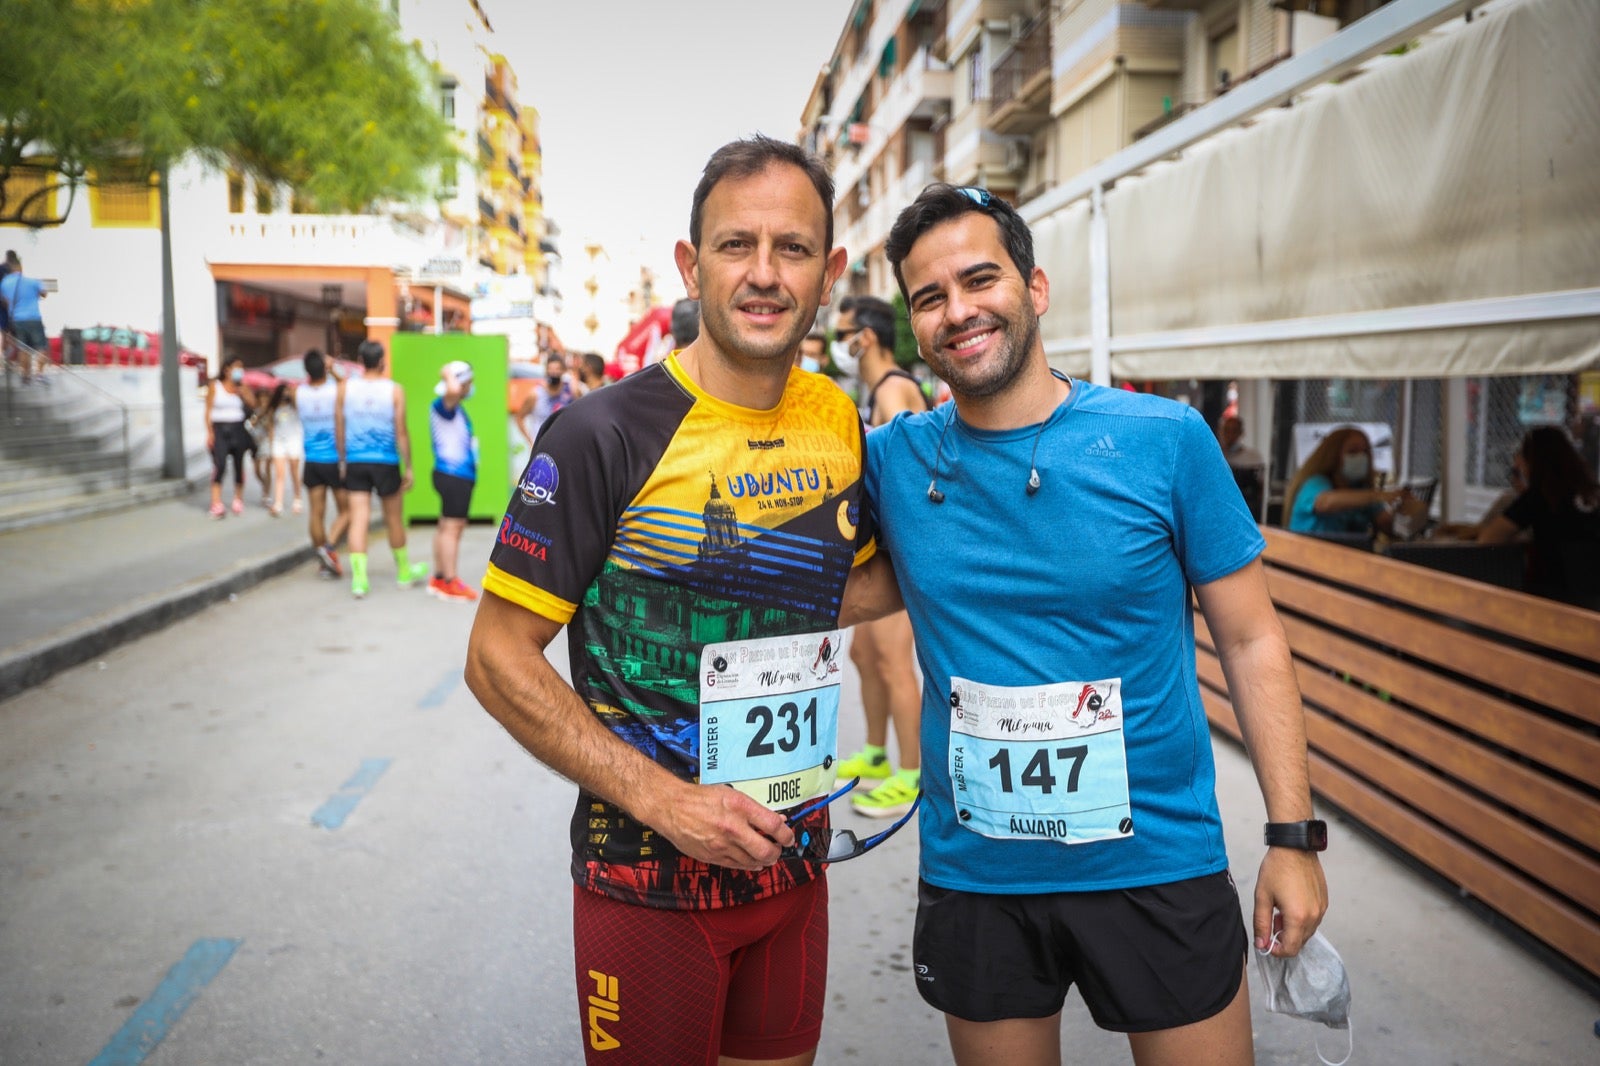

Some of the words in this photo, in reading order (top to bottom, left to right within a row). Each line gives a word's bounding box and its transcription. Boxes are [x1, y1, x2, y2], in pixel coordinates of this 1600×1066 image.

[1085, 447, 1122, 458] adidas
[727, 467, 820, 498] UBUNTU
[757, 500, 767, 510] 24
[774, 495, 804, 508] NON-STOP
[757, 670, 779, 687] Mil
[707, 716, 718, 724] B
[745, 697, 817, 758] 231
[996, 718, 1022, 733] Mil
[1031, 721, 1054, 732] una
[707, 726, 718, 770] MASTER
[956, 746, 964, 754] A
[955, 755, 967, 792] MASTER
[988, 744, 1088, 794] 147
[767, 778, 801, 804] JORGE
[1010, 815, 1067, 838] ÁLVARO
[588, 969, 621, 1052] FILA
